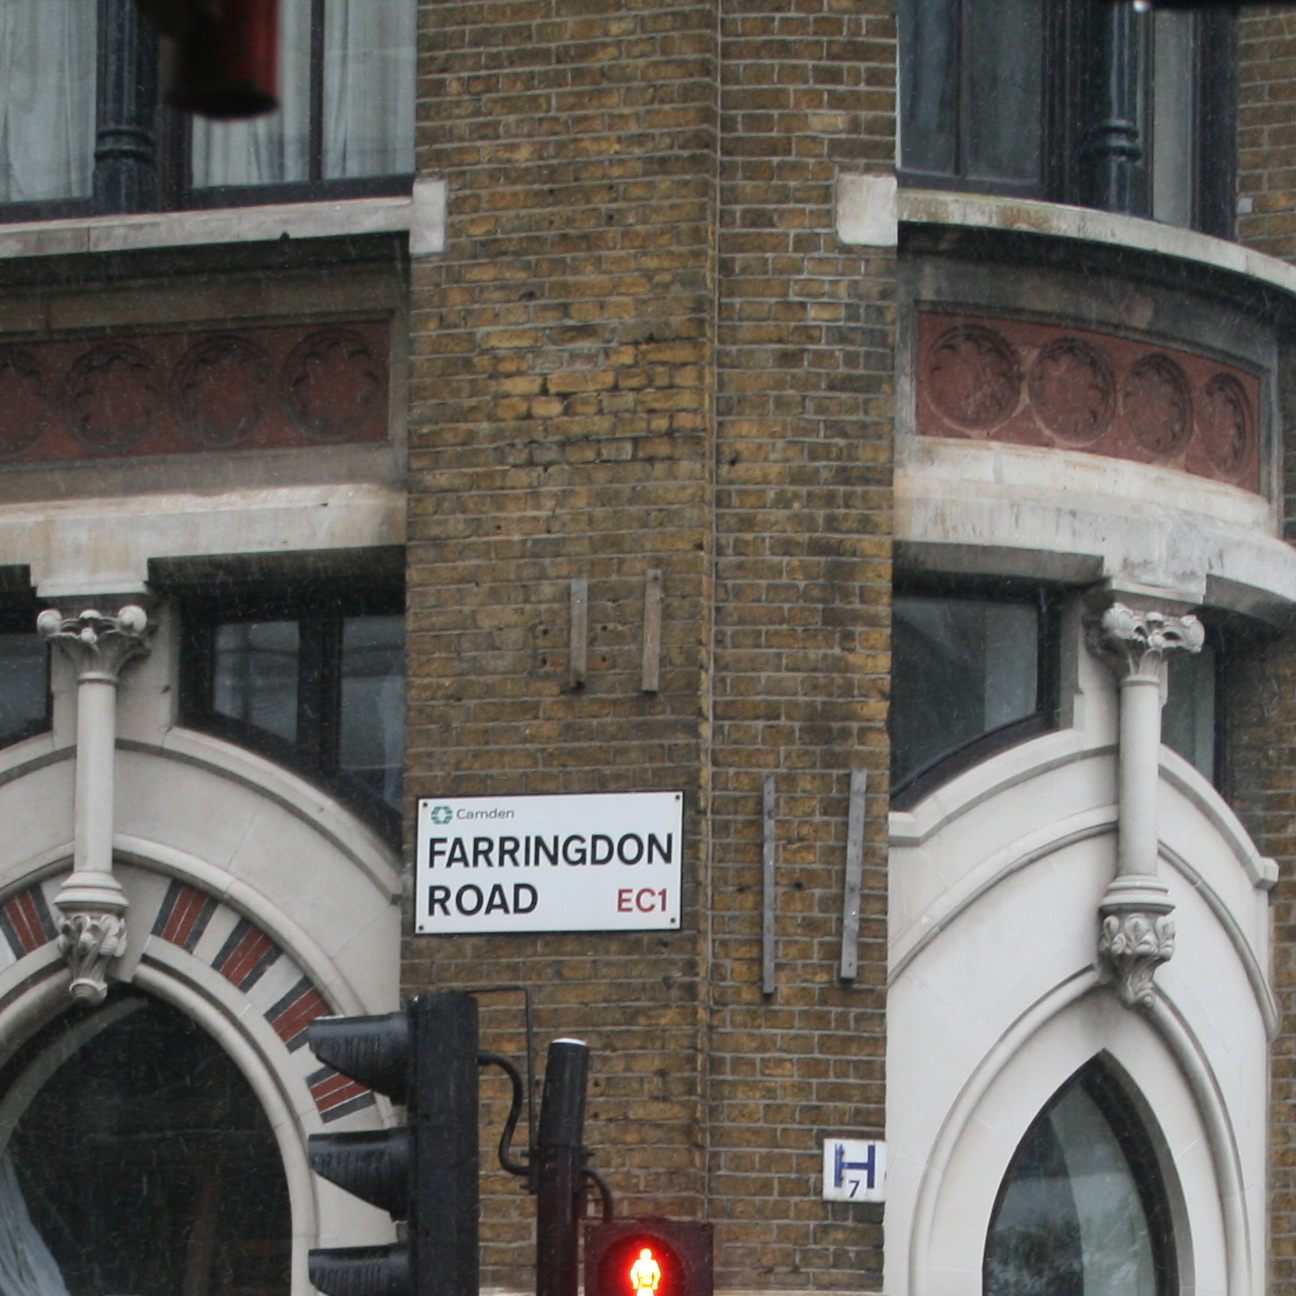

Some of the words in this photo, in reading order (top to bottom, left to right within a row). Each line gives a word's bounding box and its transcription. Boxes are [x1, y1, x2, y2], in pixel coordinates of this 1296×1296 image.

[456, 807, 515, 820] Camden
[428, 833, 673, 869] FARRINGDON
[427, 883, 538, 917] ROAD
[617, 888, 667, 912] EC1
[834, 1143, 876, 1190] H
[848, 1179, 861, 1199] 7
